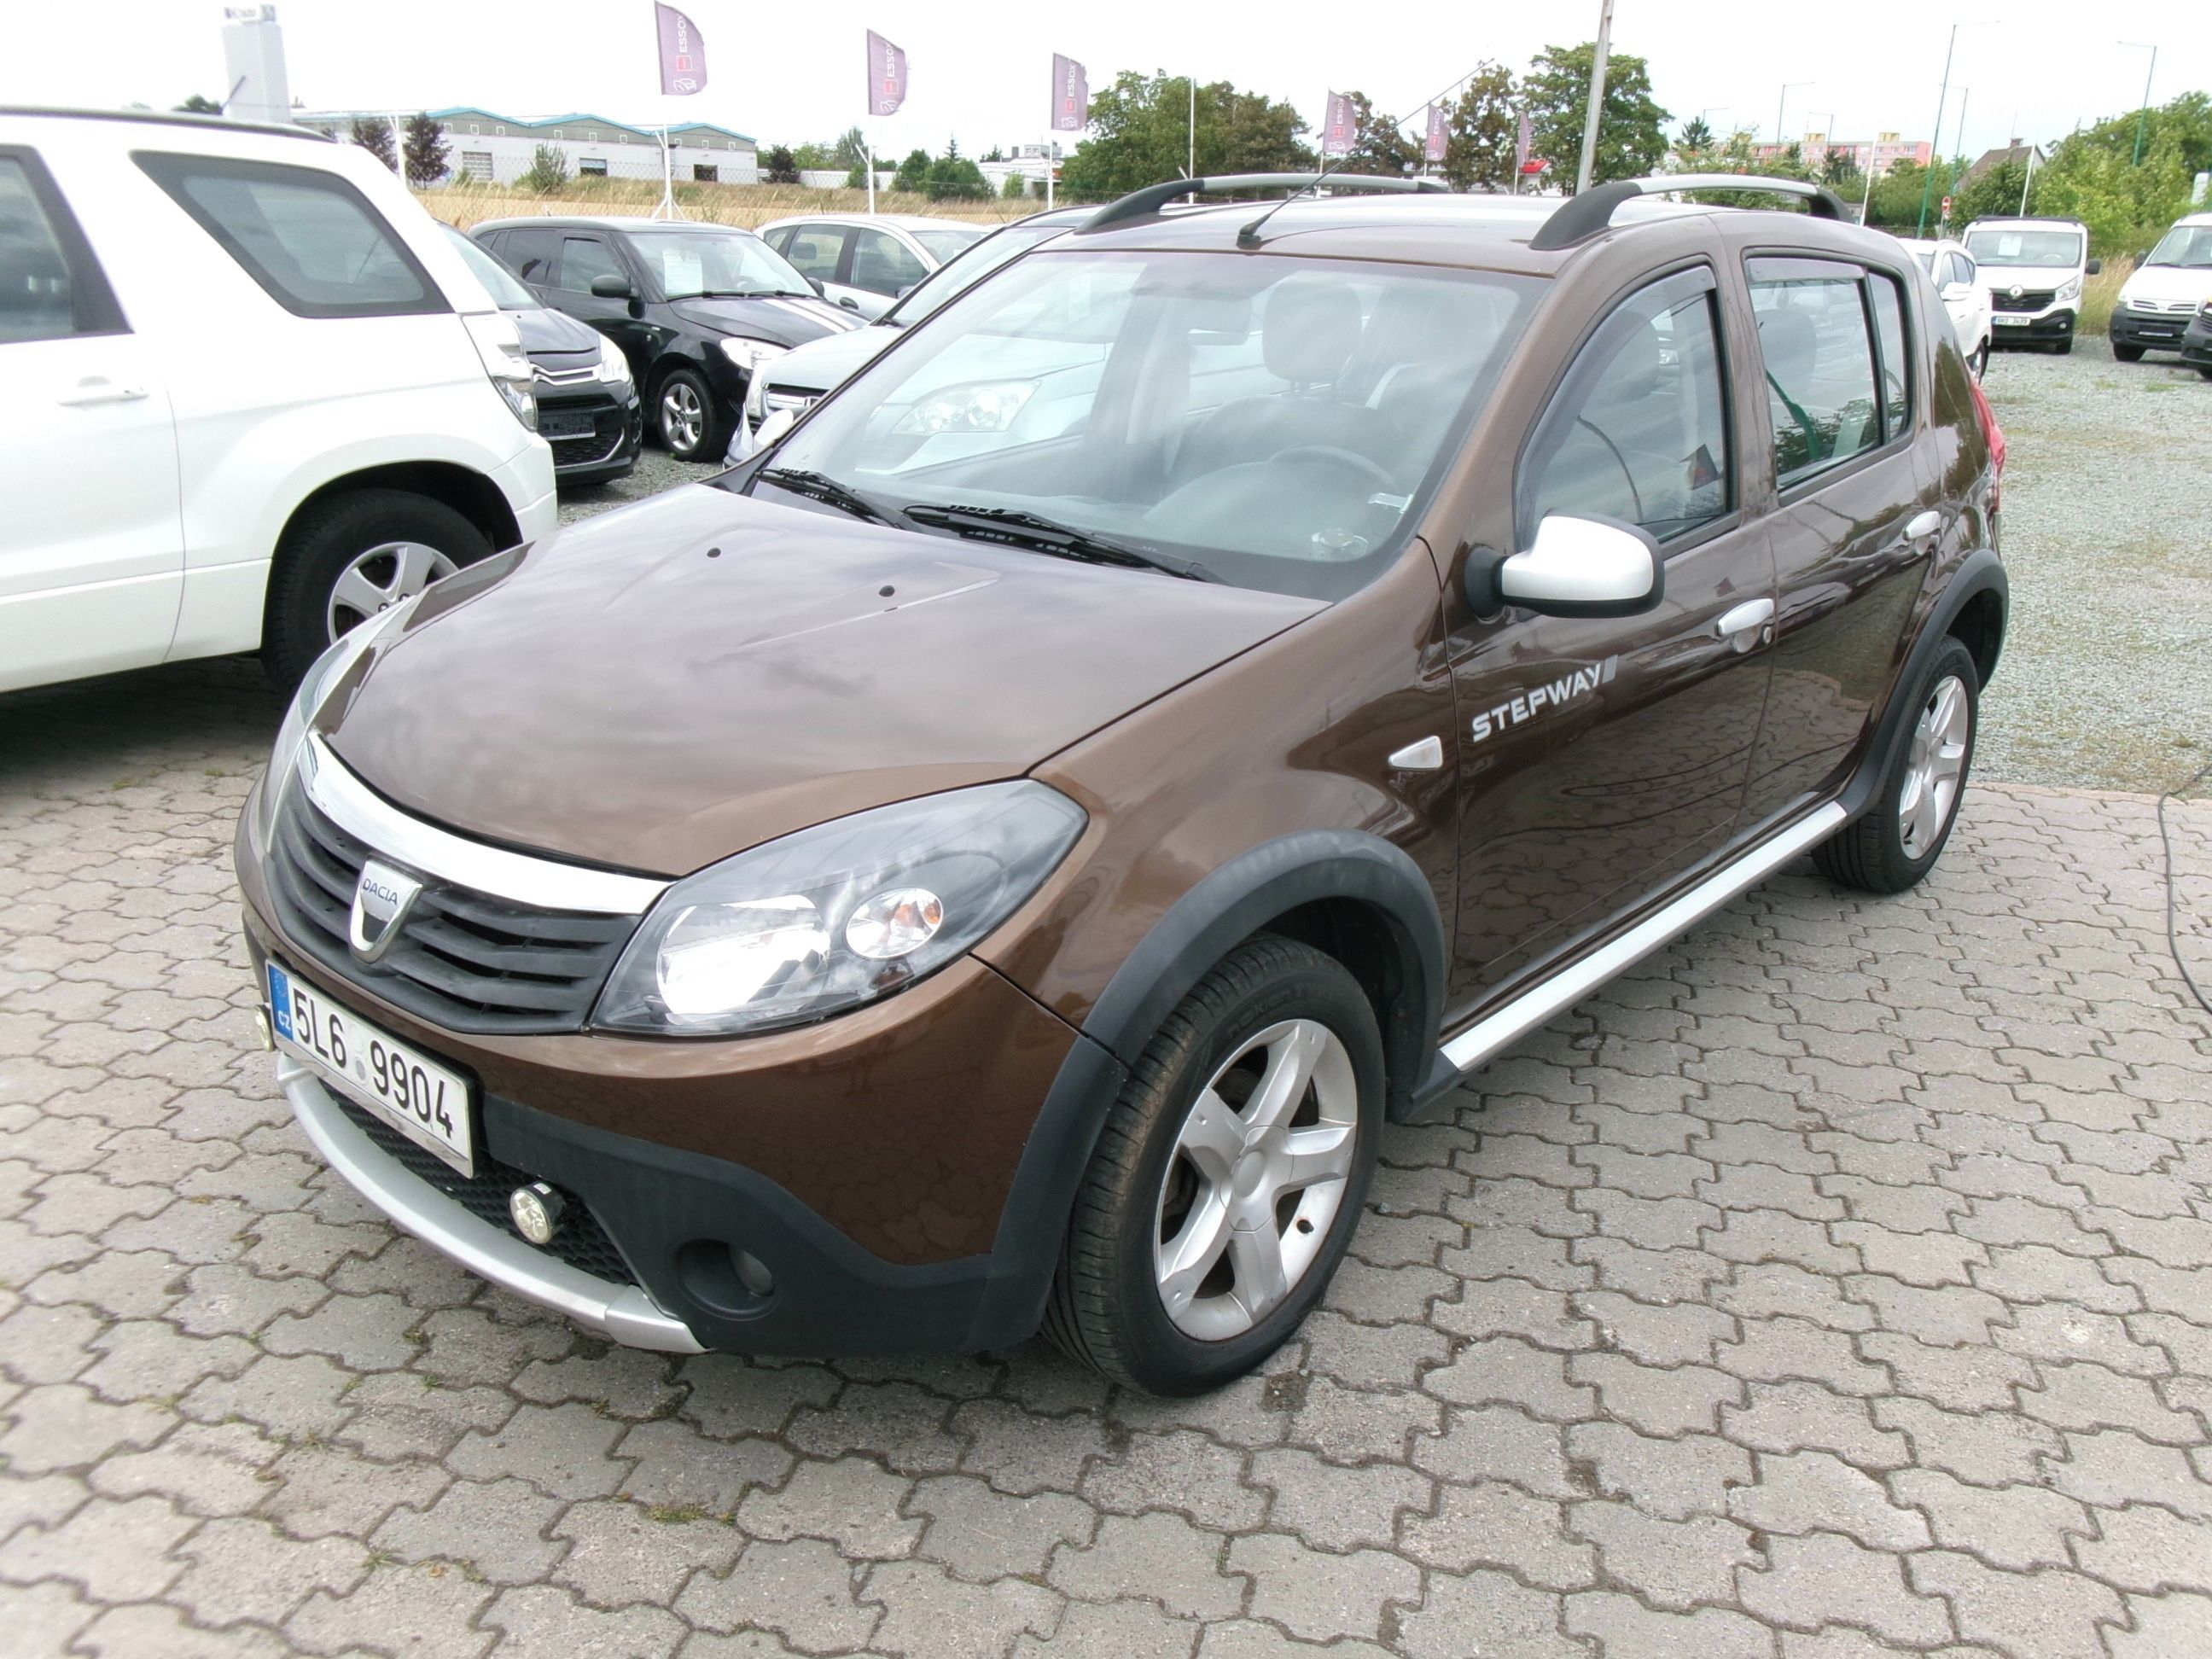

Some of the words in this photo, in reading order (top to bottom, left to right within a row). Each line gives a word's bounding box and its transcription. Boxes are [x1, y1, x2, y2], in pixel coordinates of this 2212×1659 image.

[1472, 662, 1601, 742] STEPWAY
[362, 877, 399, 905] DACIA
[277, 1010, 292, 1031] CZ
[293, 987, 347, 1068] 5L6
[369, 1039, 453, 1139] 9904
